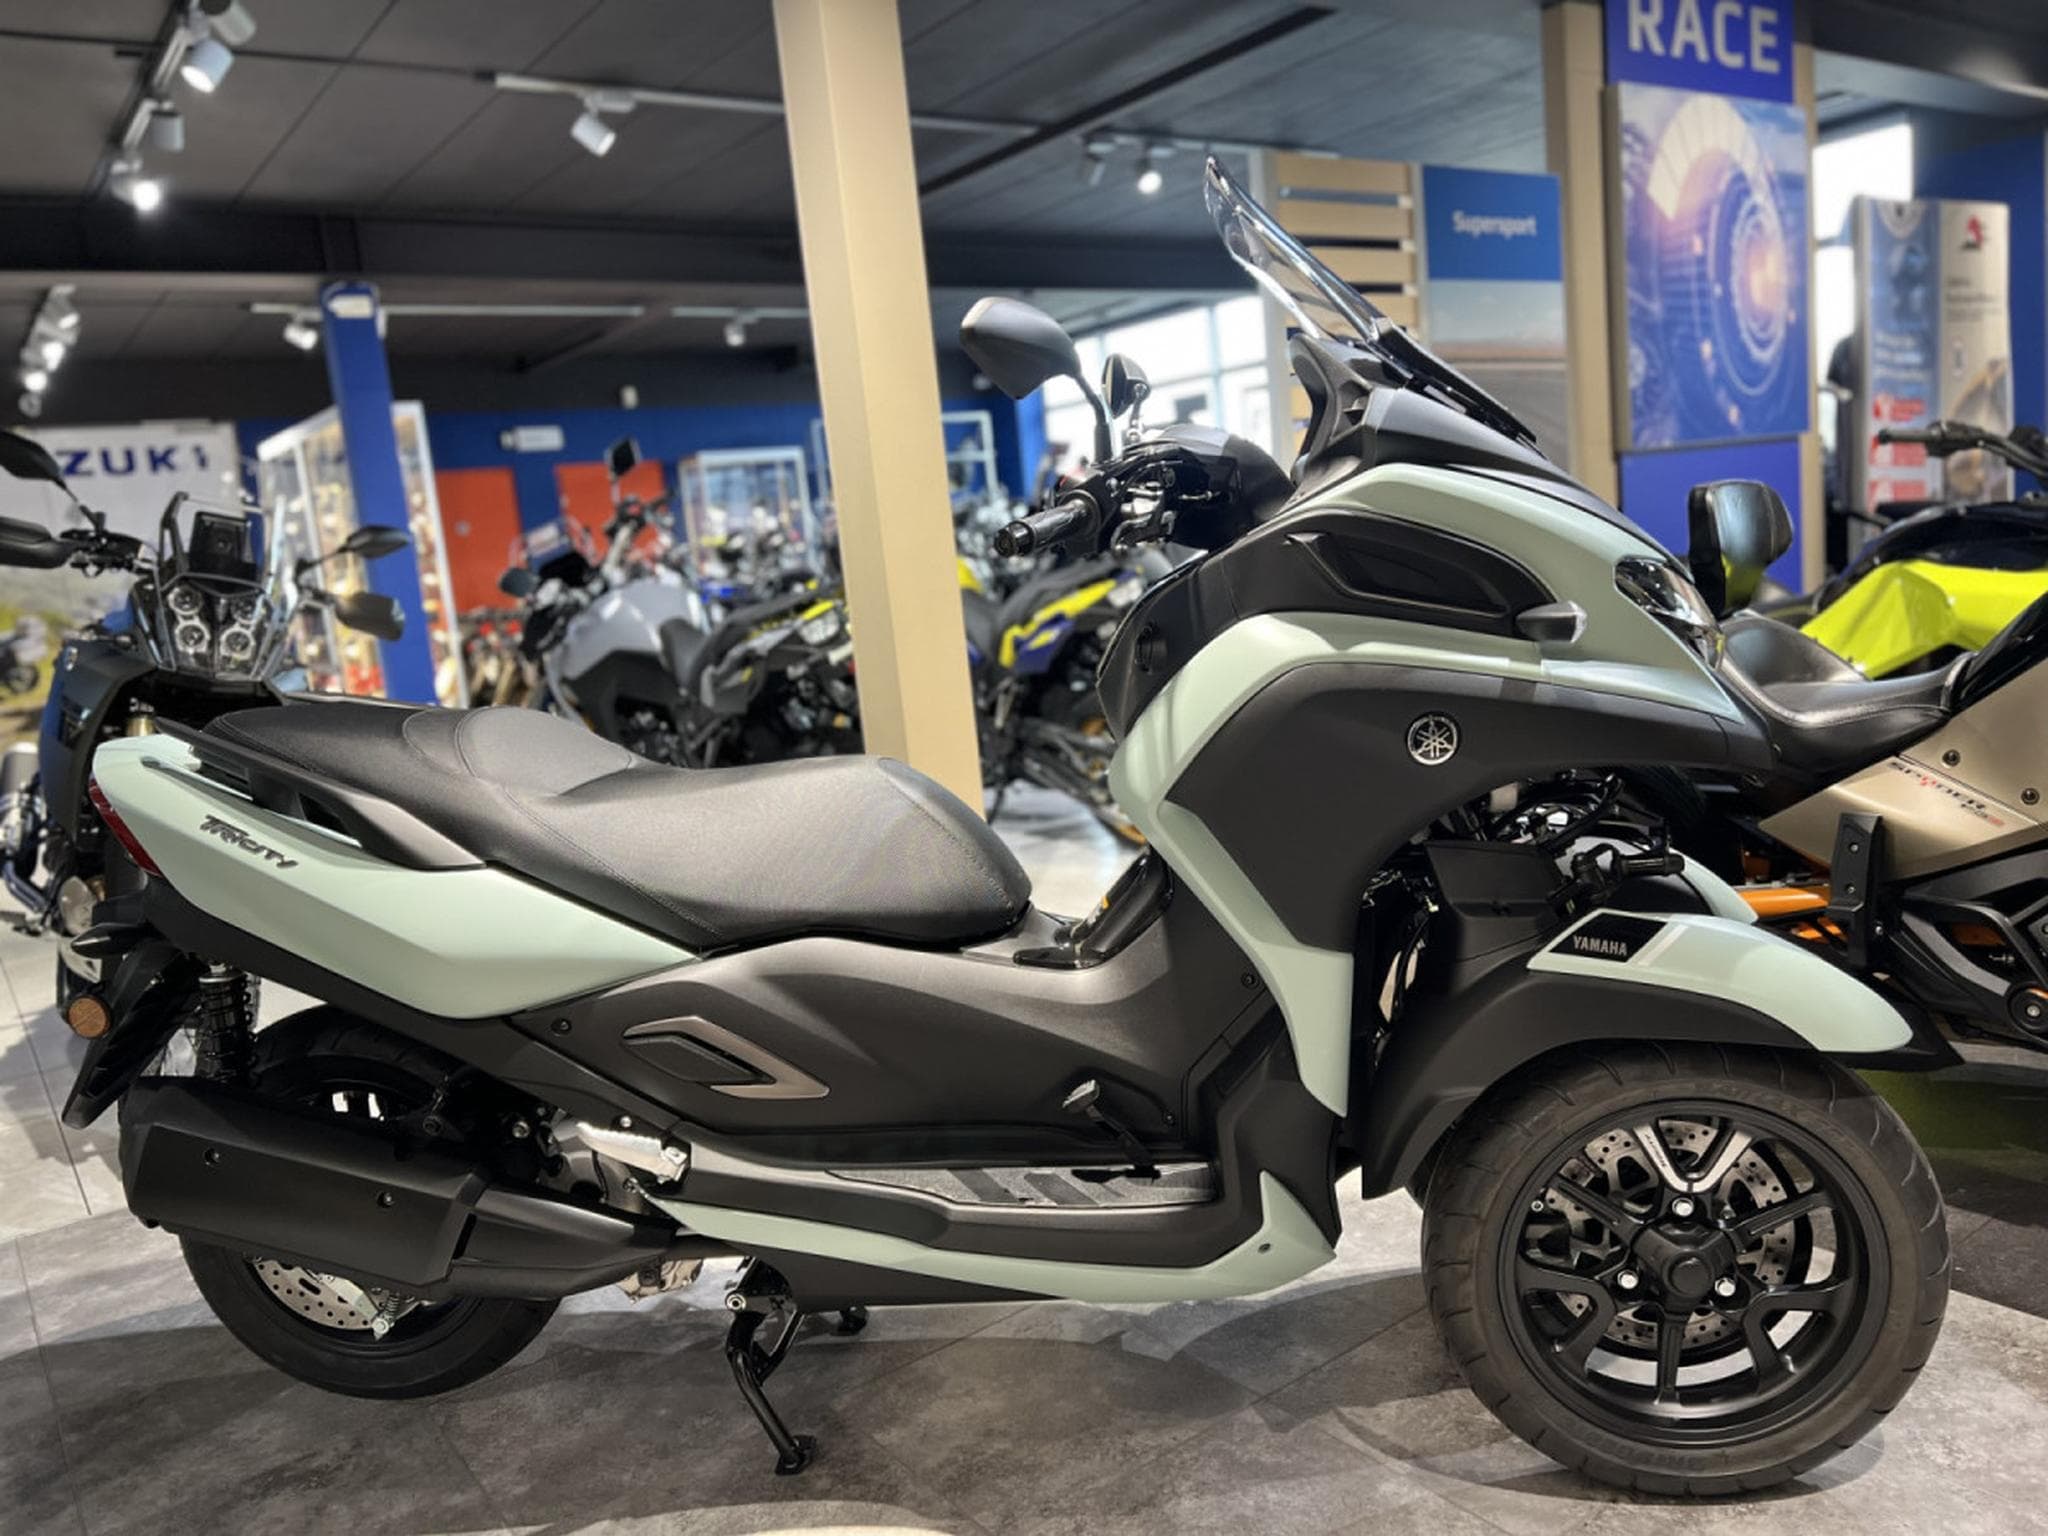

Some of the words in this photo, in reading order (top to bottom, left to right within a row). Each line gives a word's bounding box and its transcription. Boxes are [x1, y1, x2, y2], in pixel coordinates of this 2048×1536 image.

[1627, 0, 1780, 75] RACE
[1452, 209, 1537, 240] Supersport
[55, 446, 208, 478] ZUKI
[1573, 935, 1628, 956] YAMAHA
